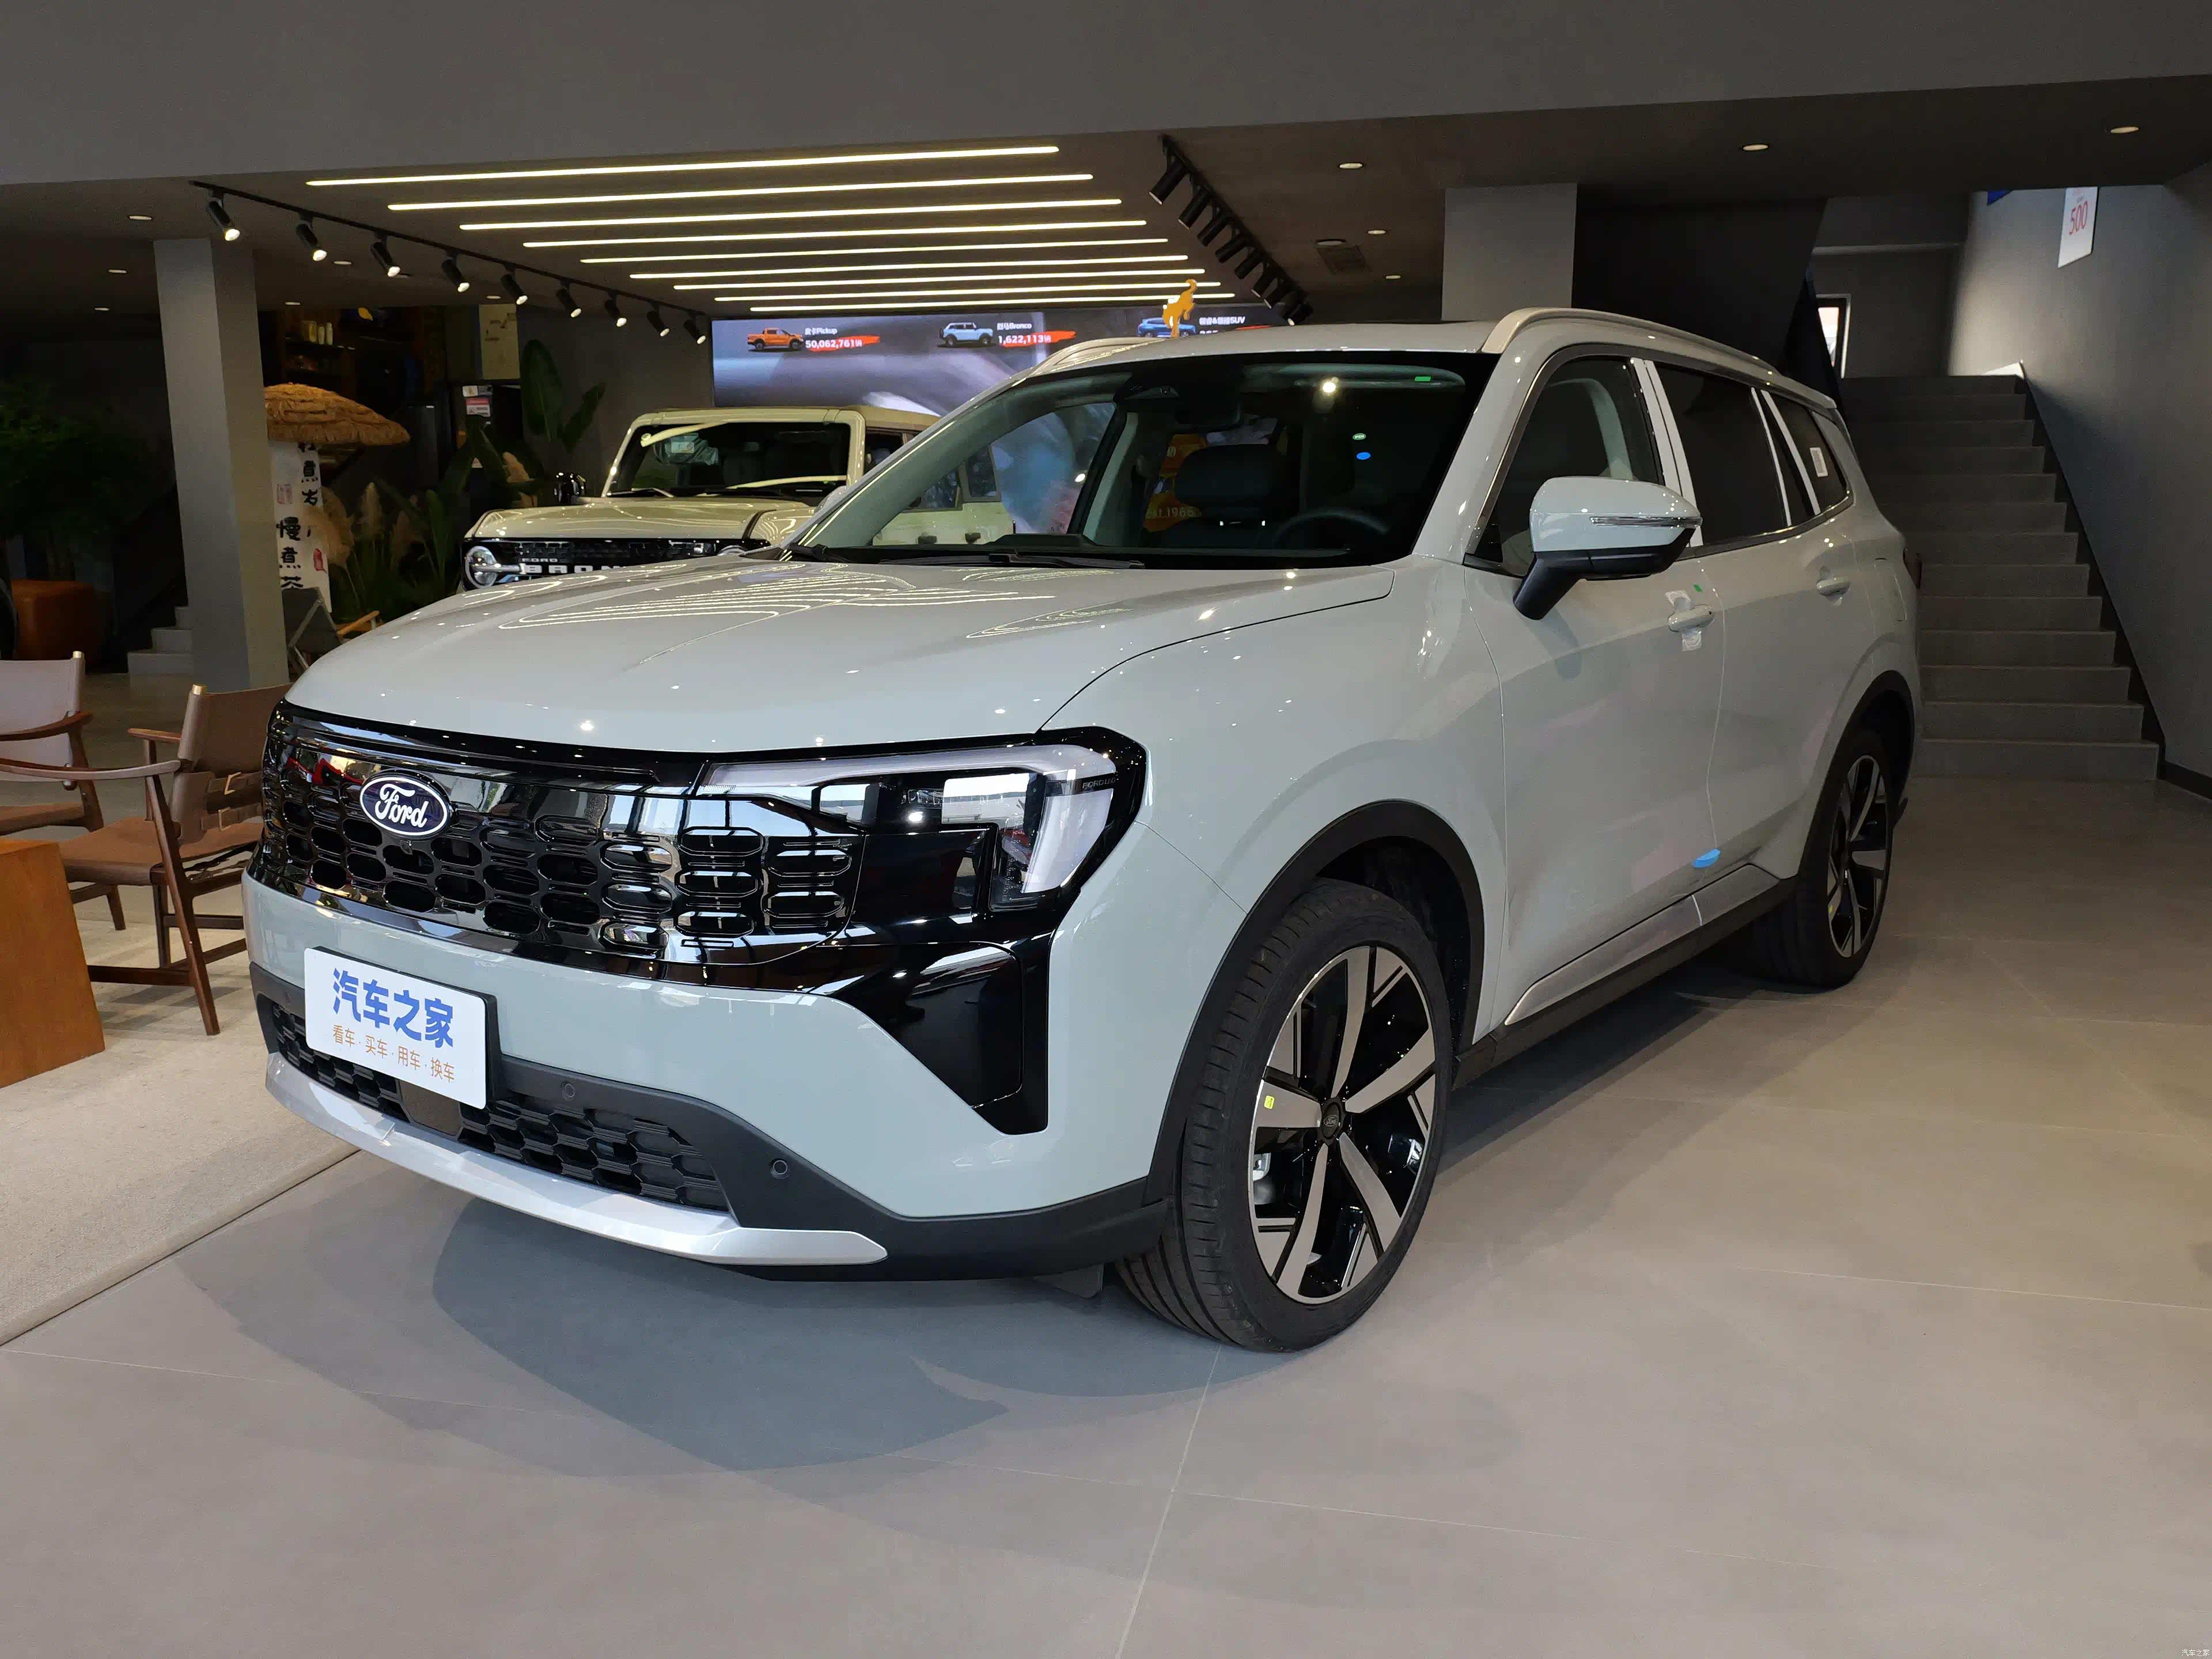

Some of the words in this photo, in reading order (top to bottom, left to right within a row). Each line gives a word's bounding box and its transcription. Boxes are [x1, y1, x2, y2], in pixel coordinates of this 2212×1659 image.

[2069, 200, 2088, 235] 500
[1082, 779, 1104, 789] FORD
[375, 783, 429, 828] Ford
[333, 968, 453, 1048] 汽车之家
